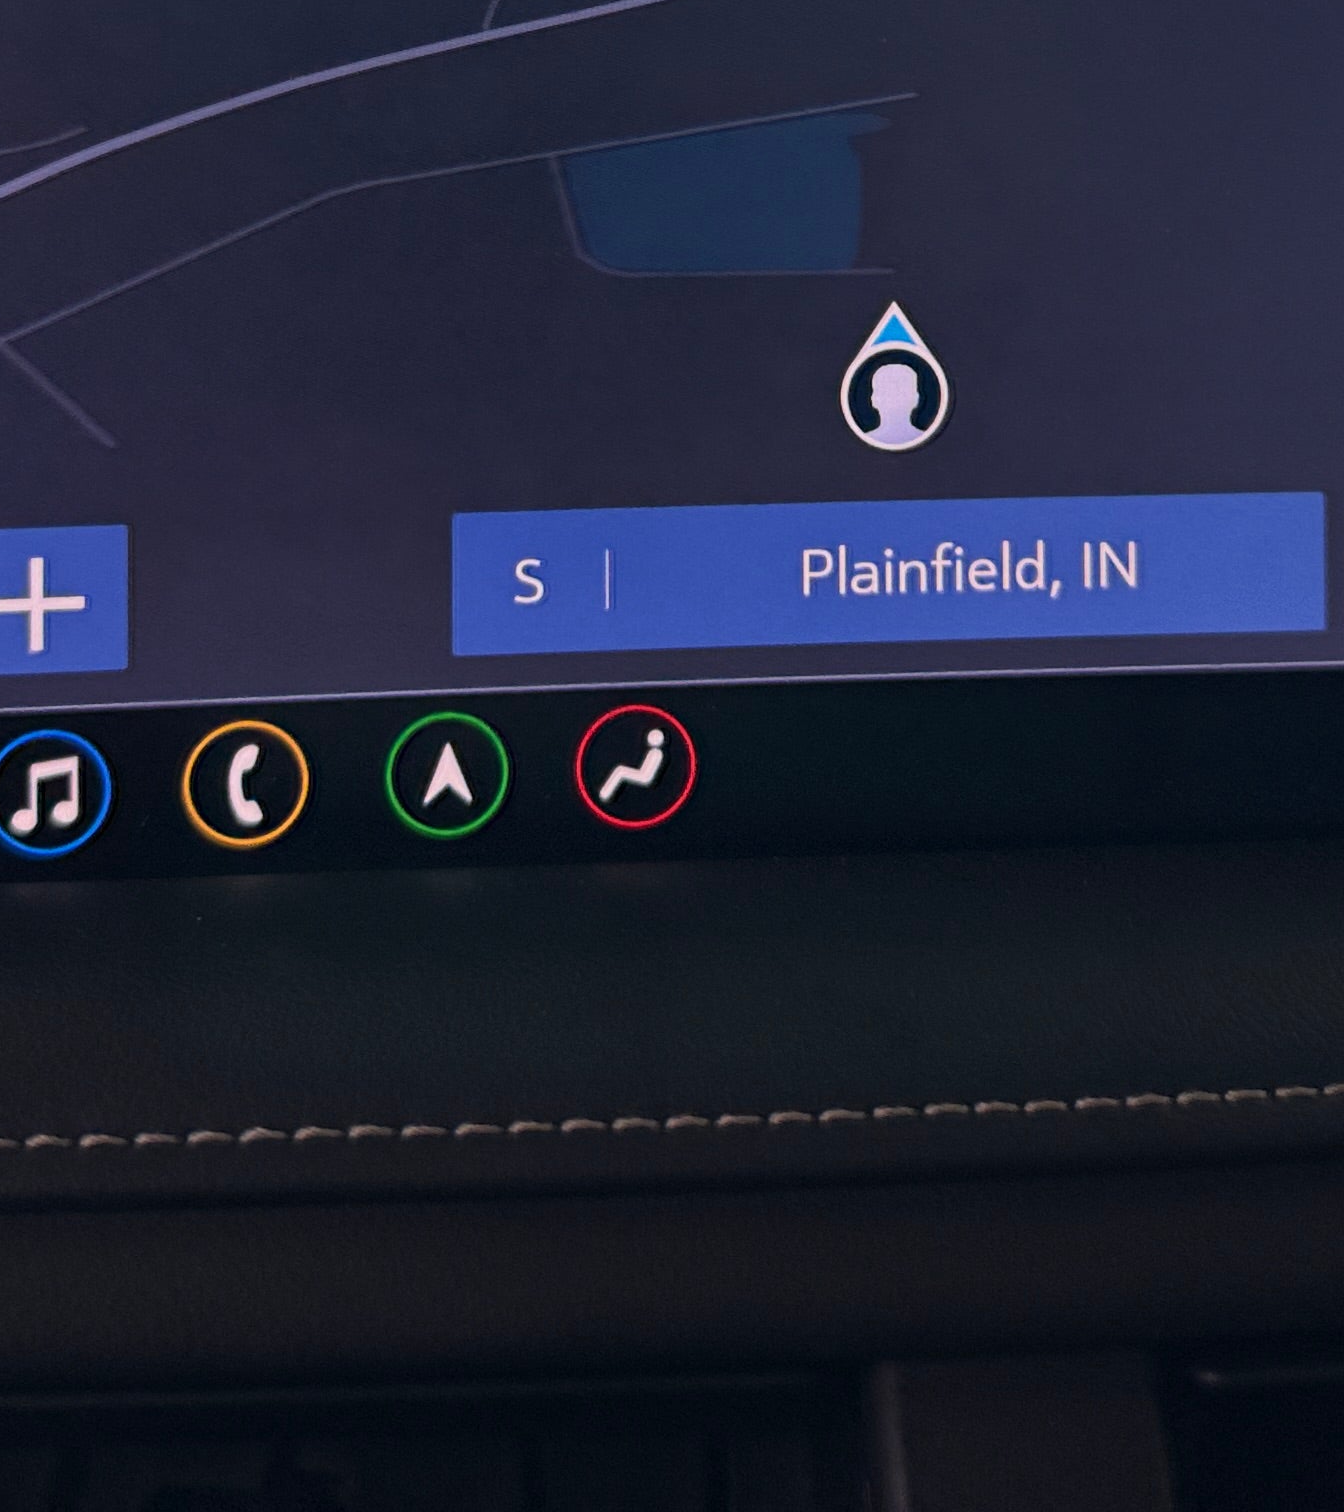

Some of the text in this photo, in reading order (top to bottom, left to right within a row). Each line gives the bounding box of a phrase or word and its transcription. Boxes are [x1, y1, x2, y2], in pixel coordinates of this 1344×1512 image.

[512, 558, 547, 604] S
[801, 538, 1139, 599] Plainfield, IN
